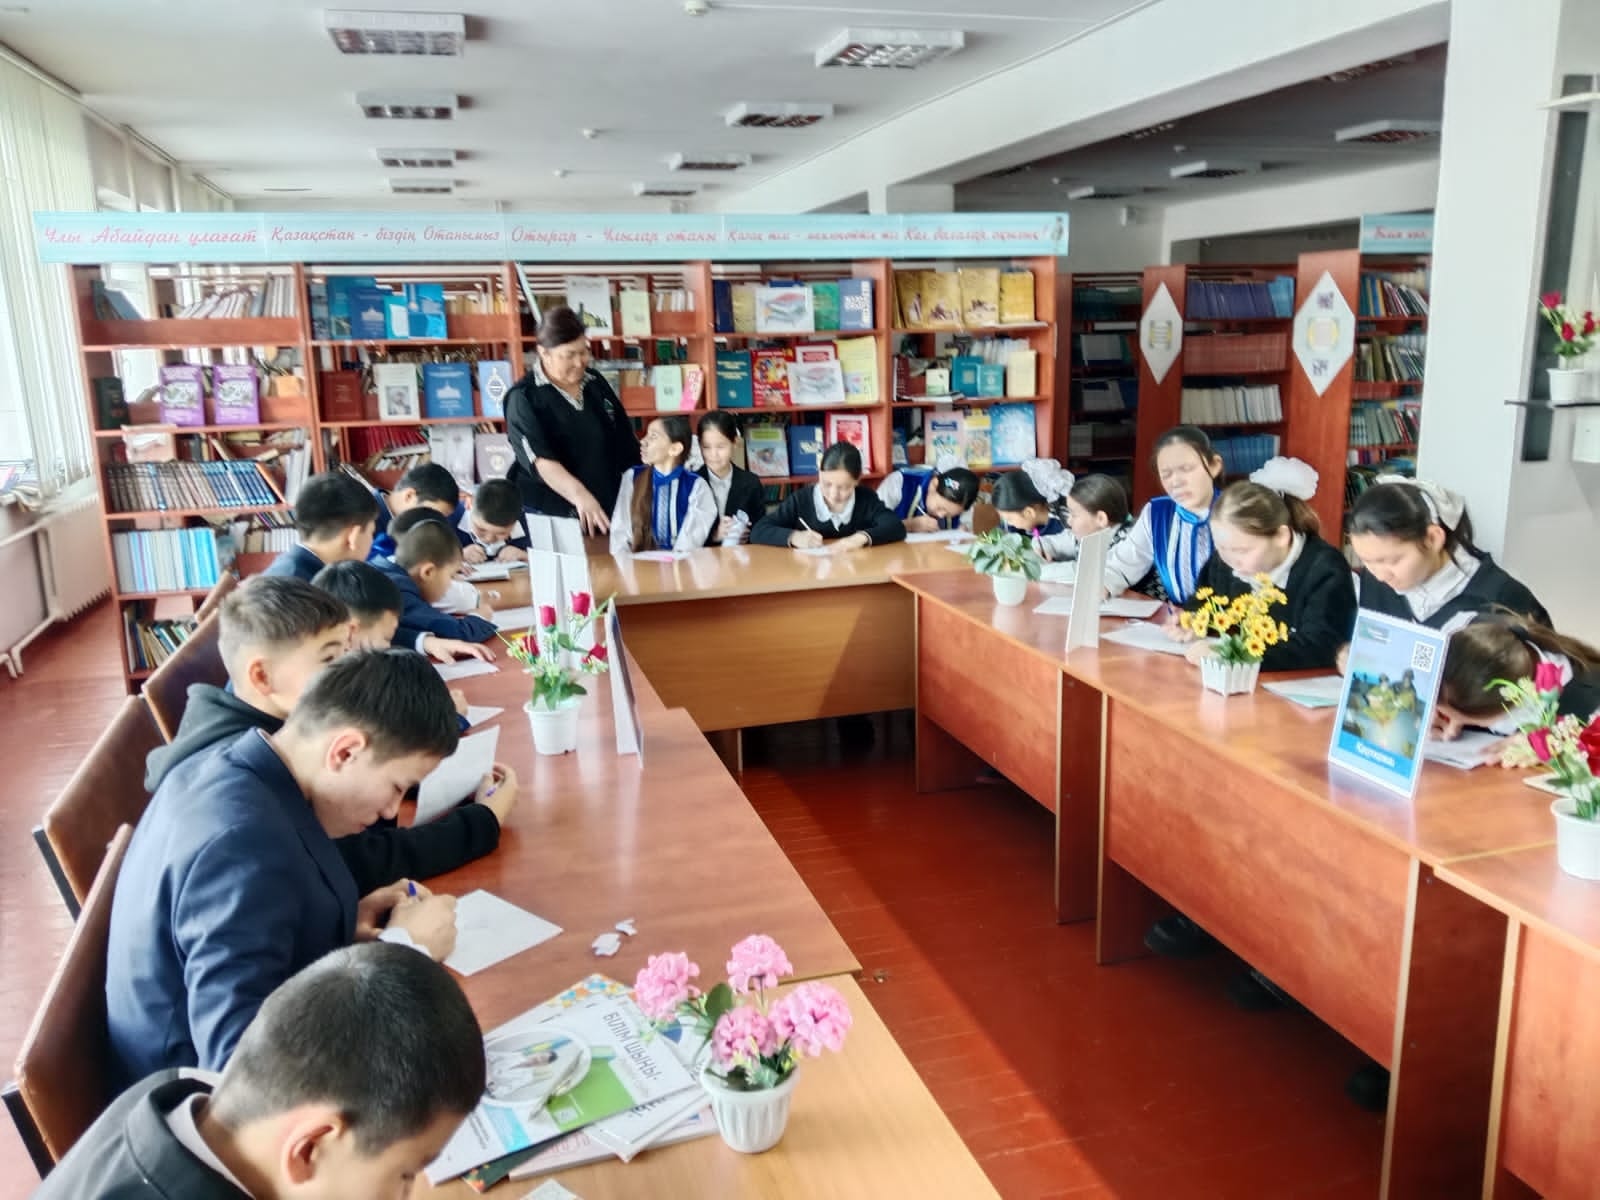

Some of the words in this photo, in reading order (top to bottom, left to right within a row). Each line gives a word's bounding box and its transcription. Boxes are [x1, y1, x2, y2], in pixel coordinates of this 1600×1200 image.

[93, 224, 181, 248] Абайдан
[271, 225, 356, 245] Қазақстан
[375, 226, 417, 247] біздің
[423, 225, 500, 241] Отанымыз
[511, 224, 577, 247] Отырар
